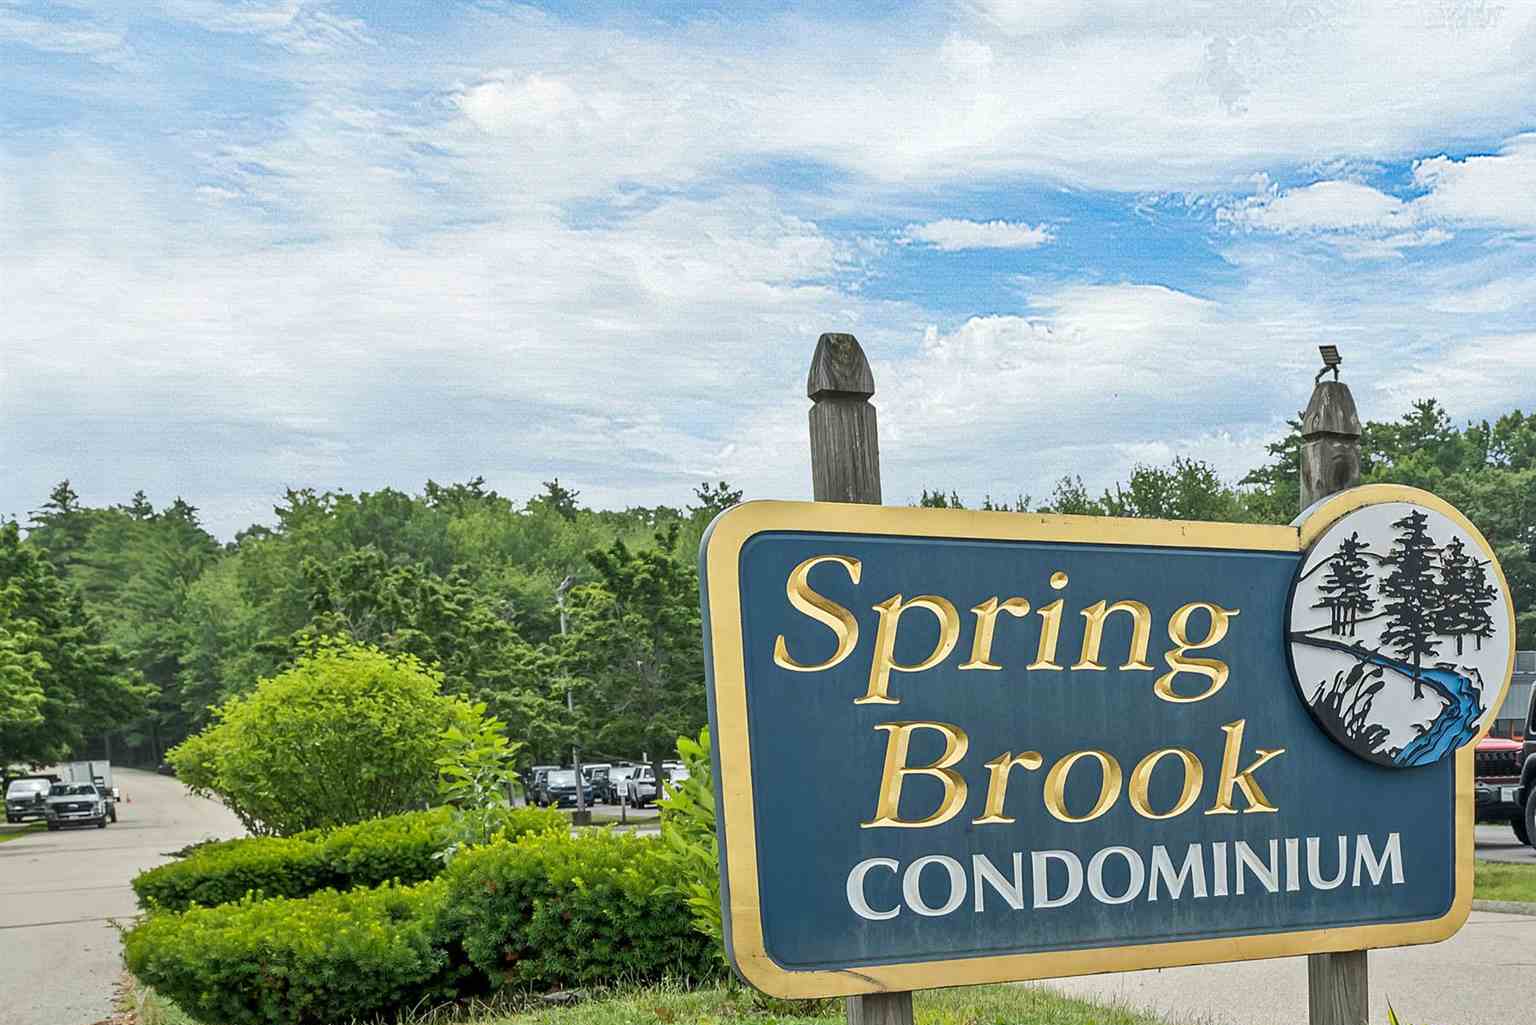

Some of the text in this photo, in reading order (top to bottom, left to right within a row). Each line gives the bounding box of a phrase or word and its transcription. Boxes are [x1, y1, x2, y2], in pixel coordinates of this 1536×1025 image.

[772, 554, 1241, 705] Spring
[860, 719, 1286, 829] Brook
[845, 832, 1406, 921] CONDOMINIUM
